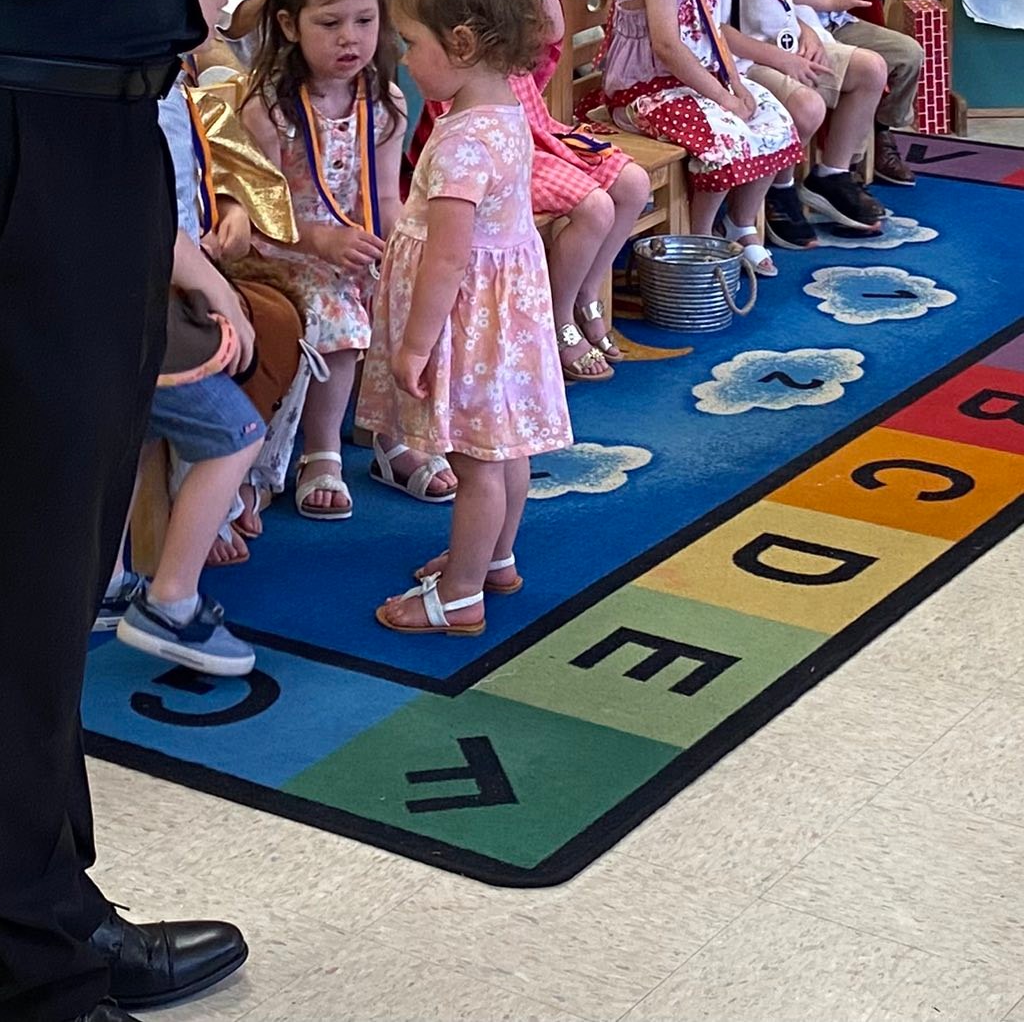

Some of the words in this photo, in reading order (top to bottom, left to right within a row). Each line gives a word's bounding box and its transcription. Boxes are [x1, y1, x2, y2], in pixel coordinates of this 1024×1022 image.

[850, 458, 976, 502] C
[732, 532, 880, 586] D
[569, 626, 744, 698] E
[405, 735, 519, 814] F
